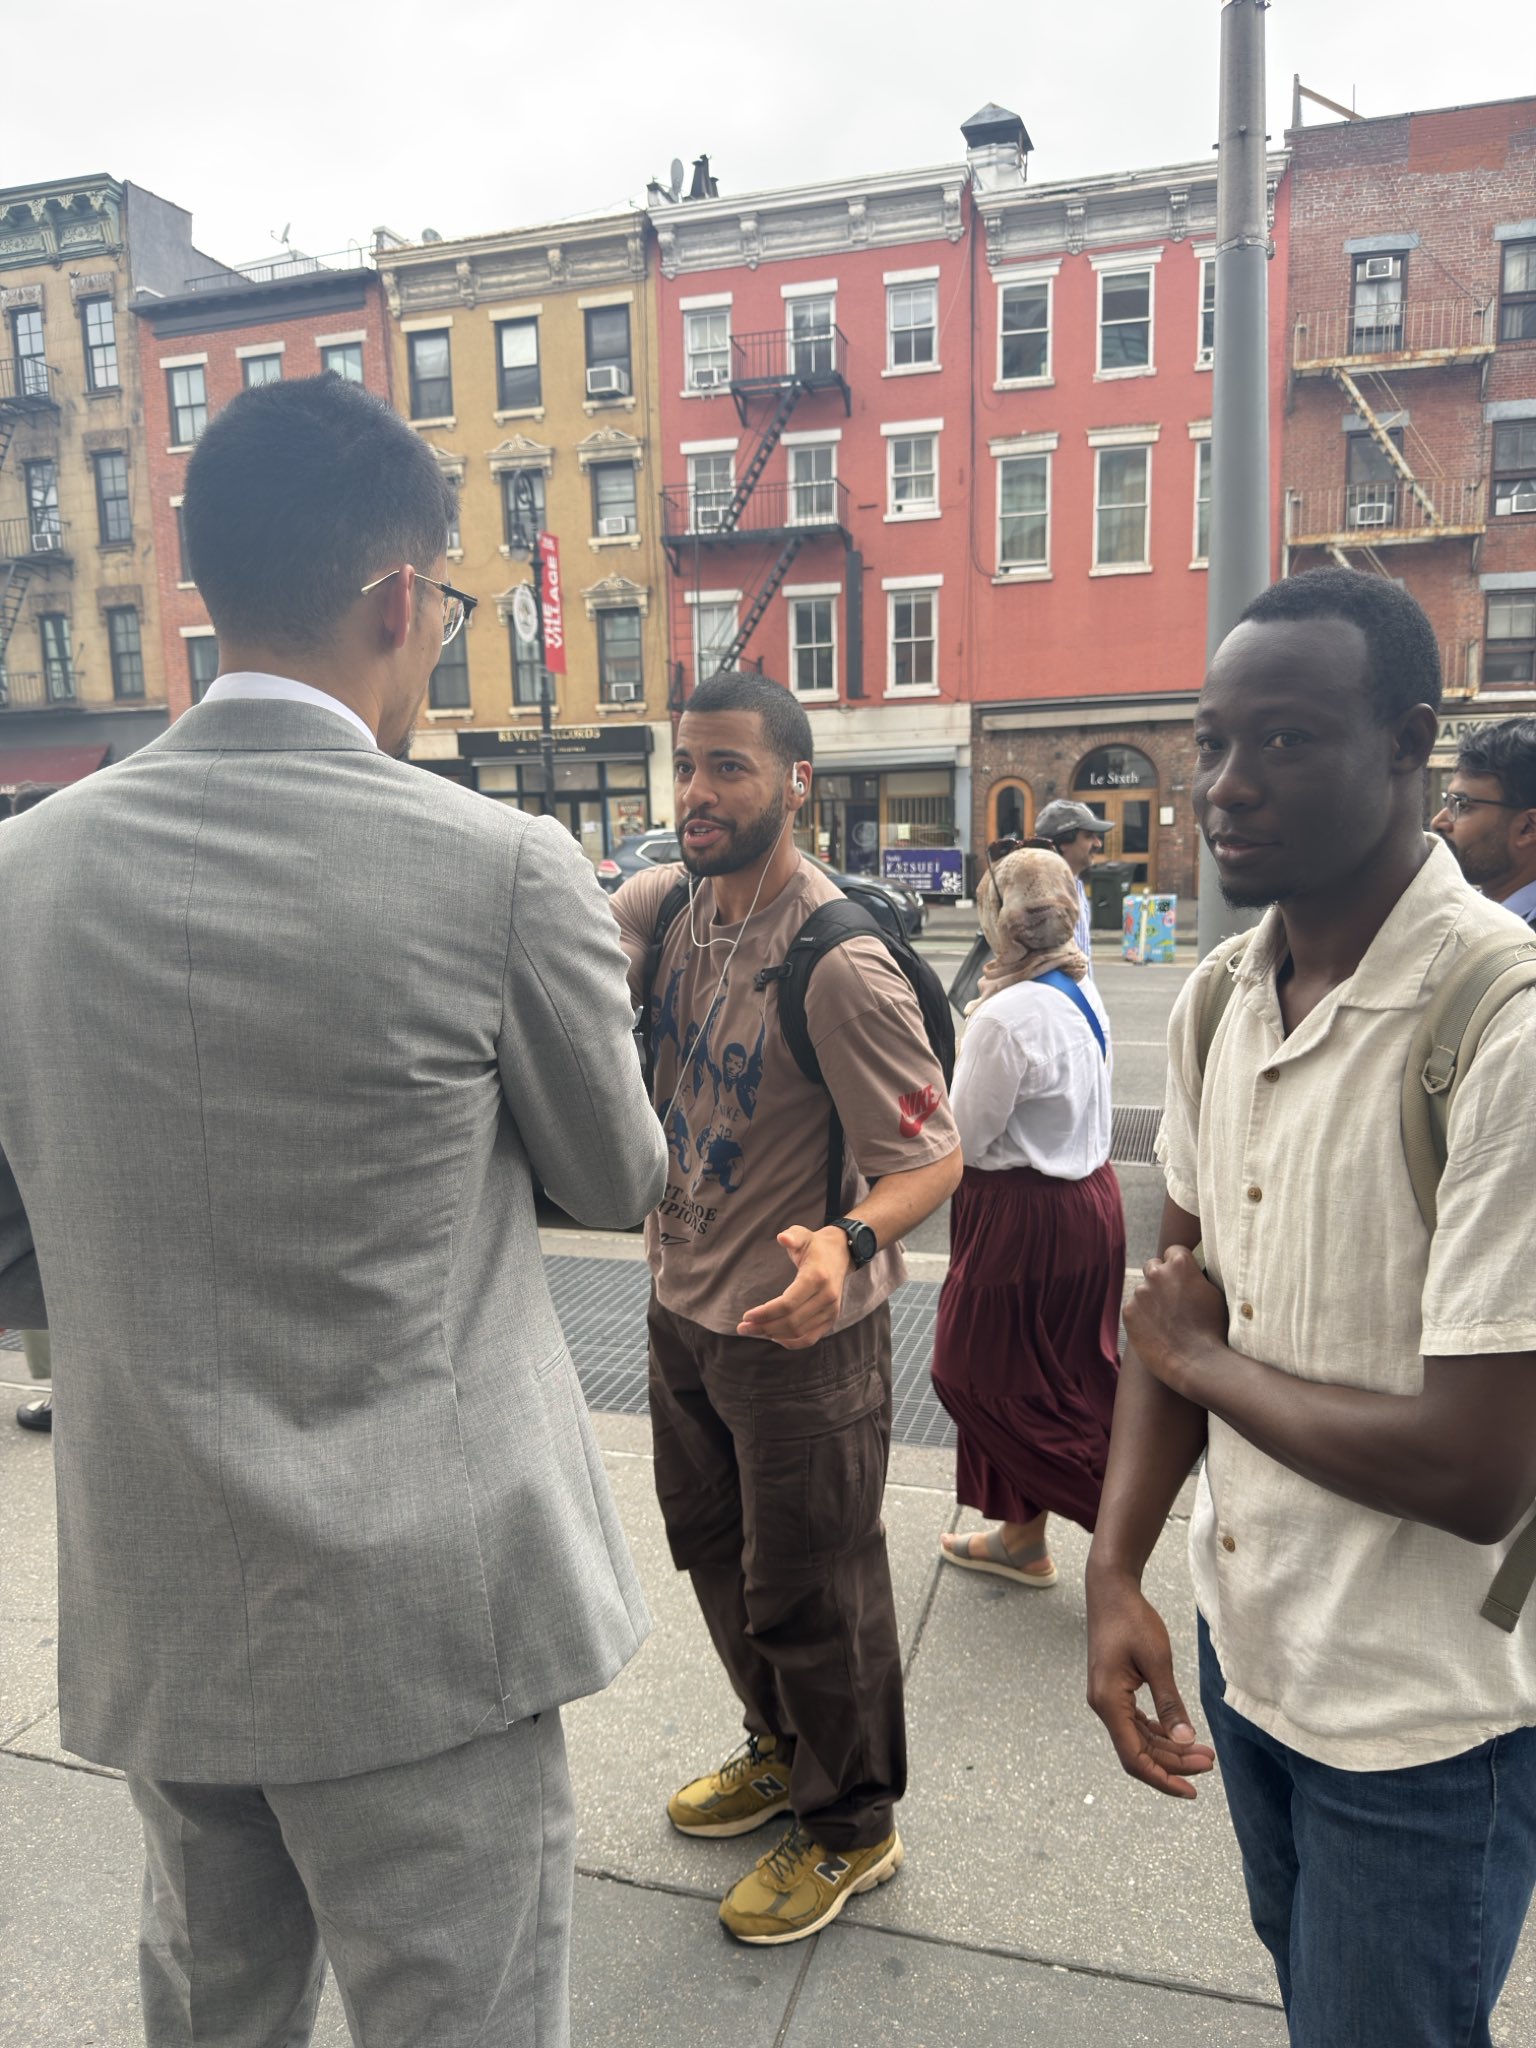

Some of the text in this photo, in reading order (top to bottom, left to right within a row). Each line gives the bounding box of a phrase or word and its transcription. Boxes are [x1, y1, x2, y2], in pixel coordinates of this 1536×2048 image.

[547, 555, 562, 649] VILLAGE
[1090, 770, 1140, 785] Le Sixth
[898, 1083, 935, 1117] NIKE
[683, 1194, 718, 1221] SHOE
